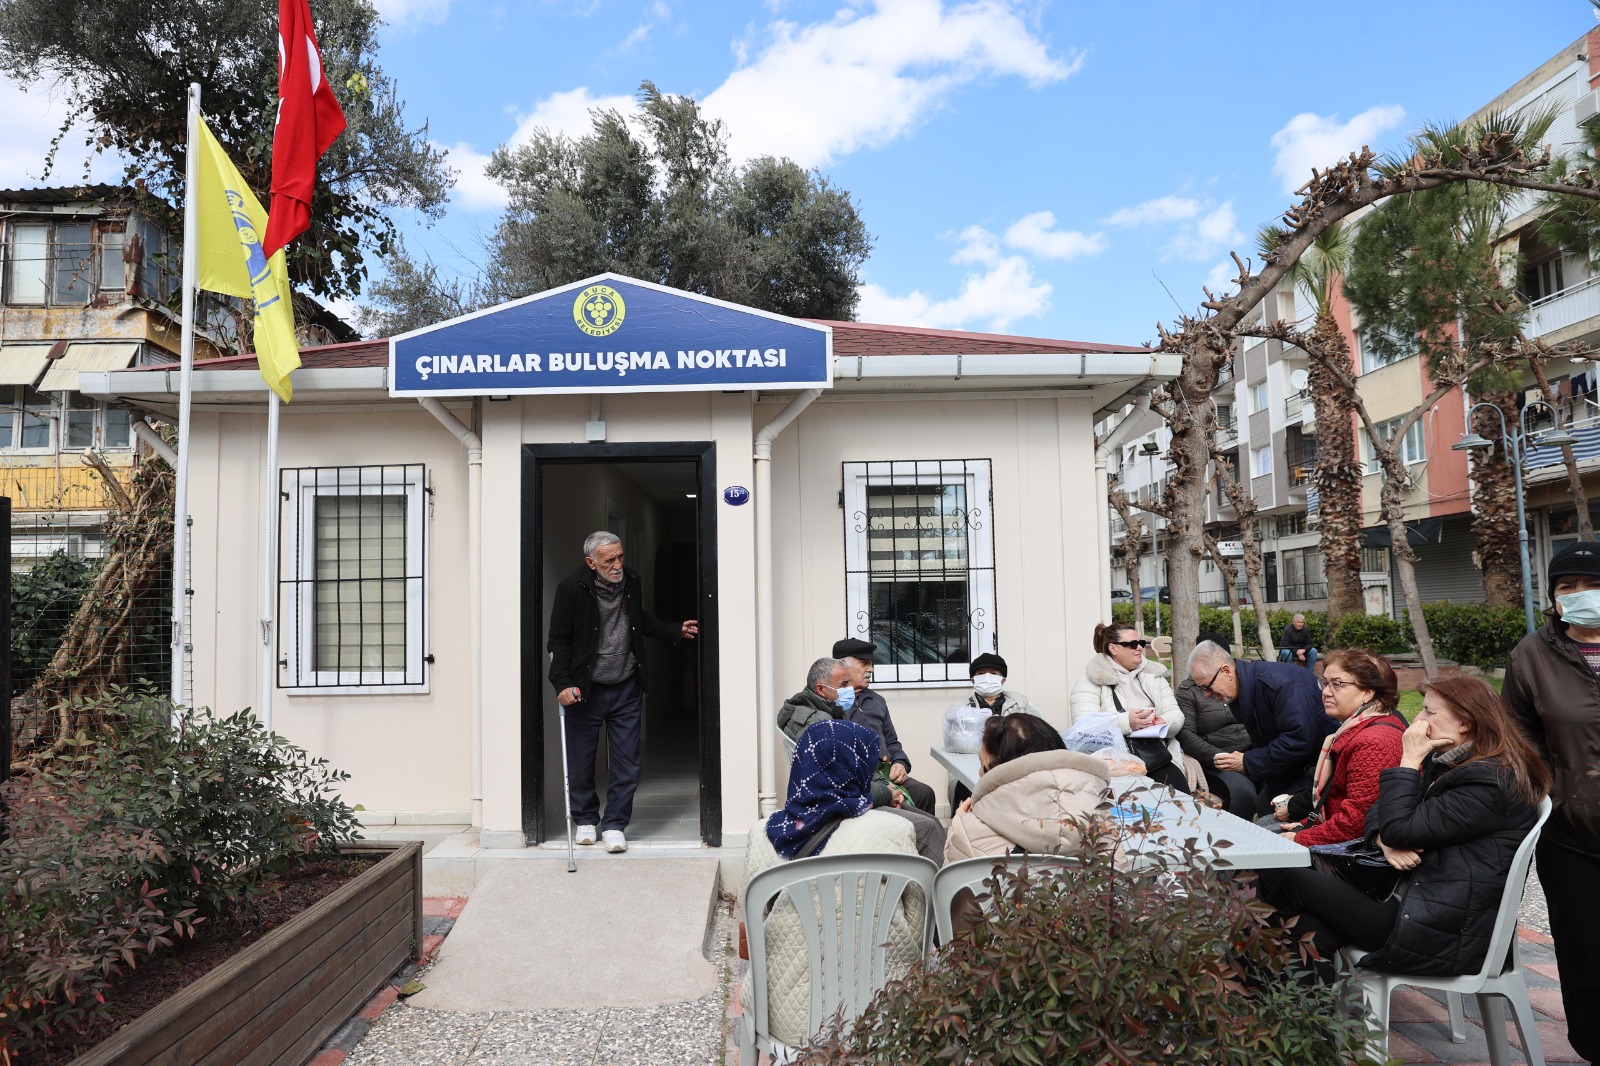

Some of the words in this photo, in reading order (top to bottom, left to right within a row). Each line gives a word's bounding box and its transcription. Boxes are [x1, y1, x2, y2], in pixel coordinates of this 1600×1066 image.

[583, 287, 615, 297] BUCA
[576, 317, 622, 336] BELEDİYESİ
[415, 355, 542, 381] ÇINARLAR
[549, 351, 671, 377] BULUŞMA
[677, 348, 787, 369] NOKTASI
